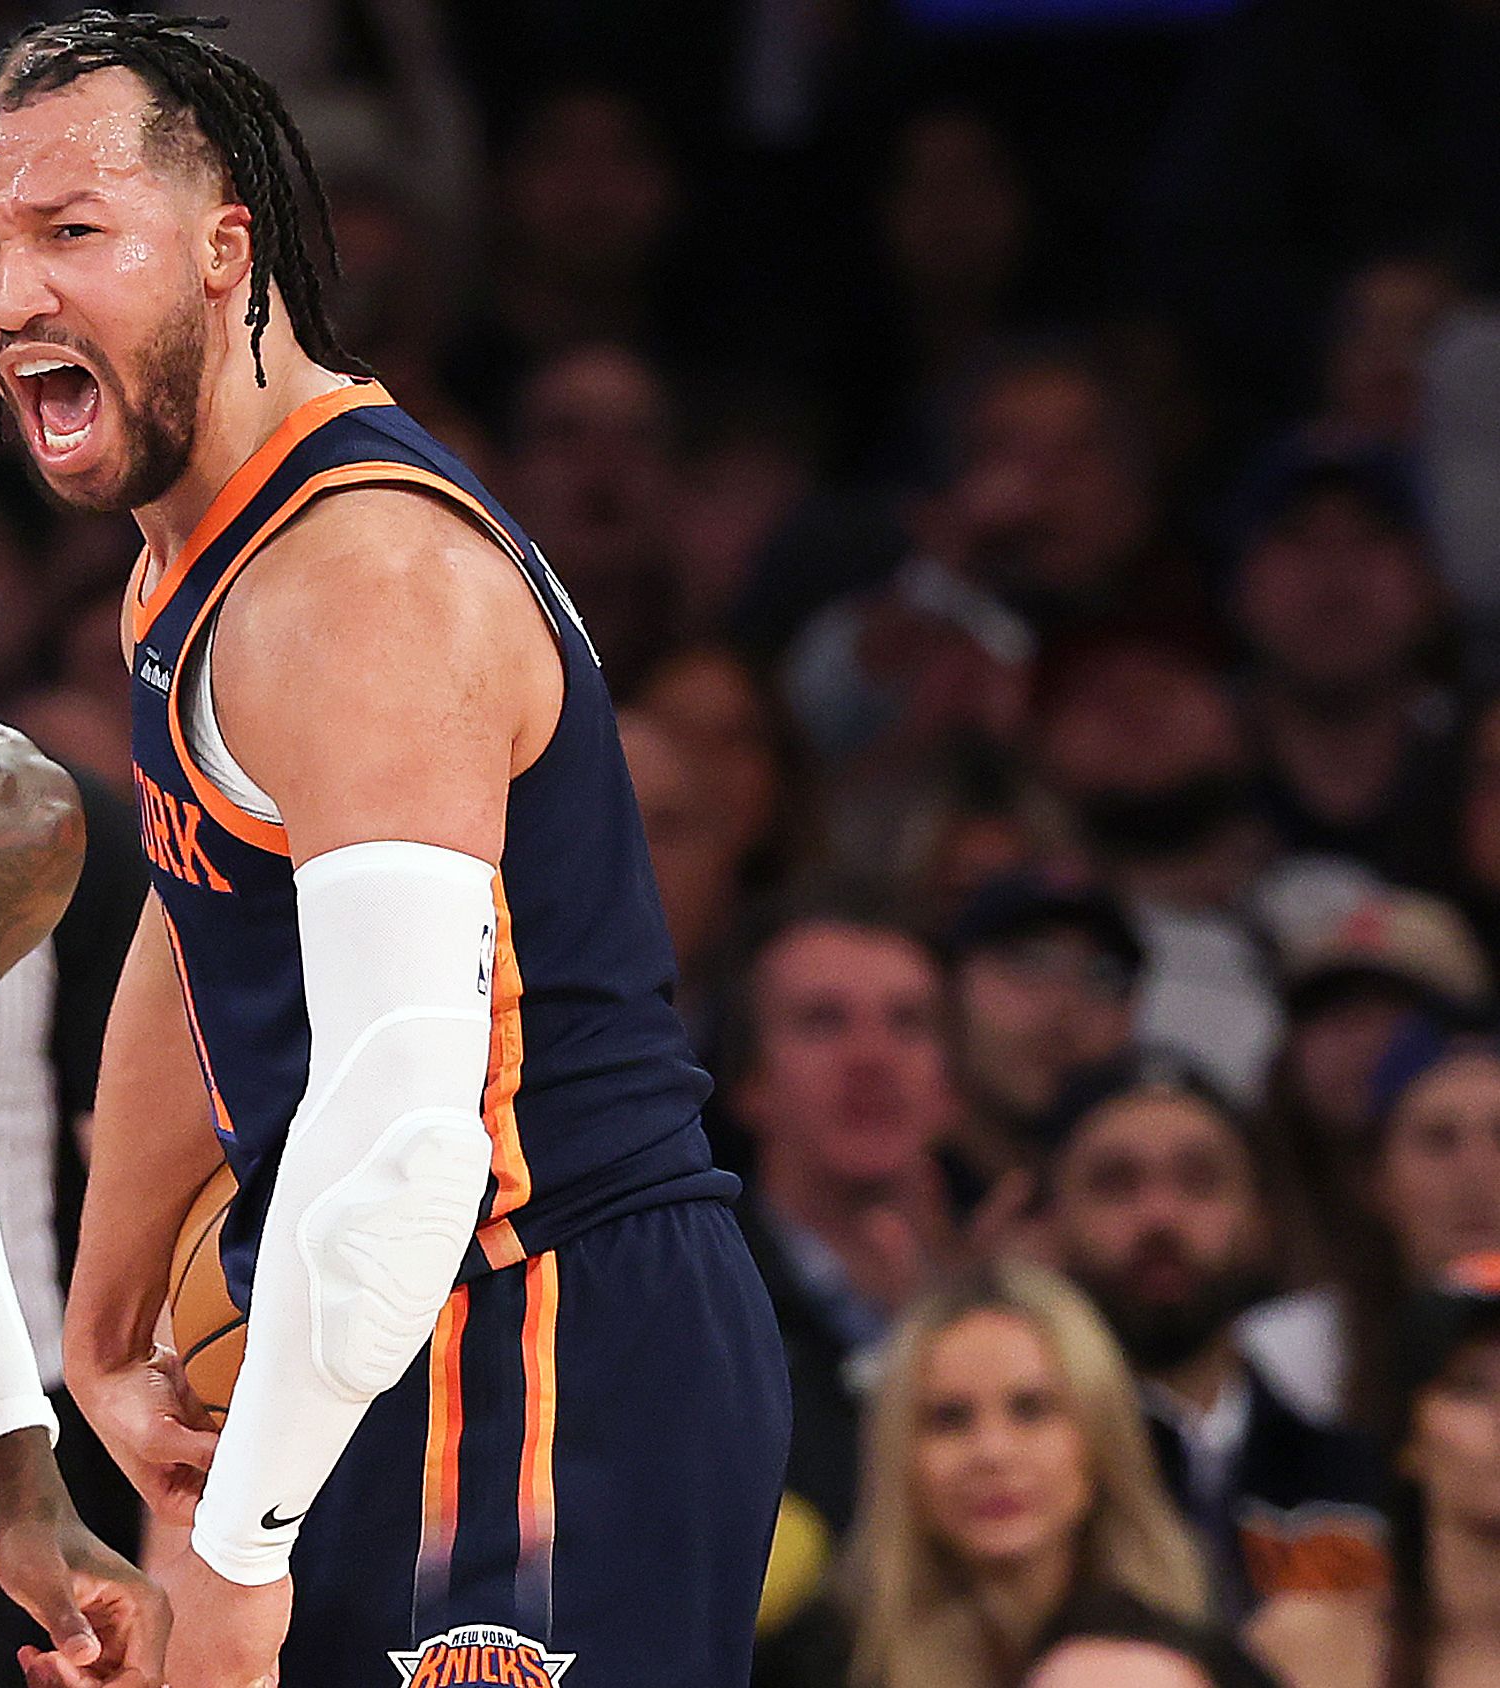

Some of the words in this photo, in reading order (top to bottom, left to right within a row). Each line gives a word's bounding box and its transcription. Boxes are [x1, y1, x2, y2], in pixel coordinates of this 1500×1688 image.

[132, 760, 233, 893] ORK
[451, 1630, 479, 1646] NEW
[482, 1630, 514, 1647] YORK
[408, 1643, 552, 1688] KNICKS
